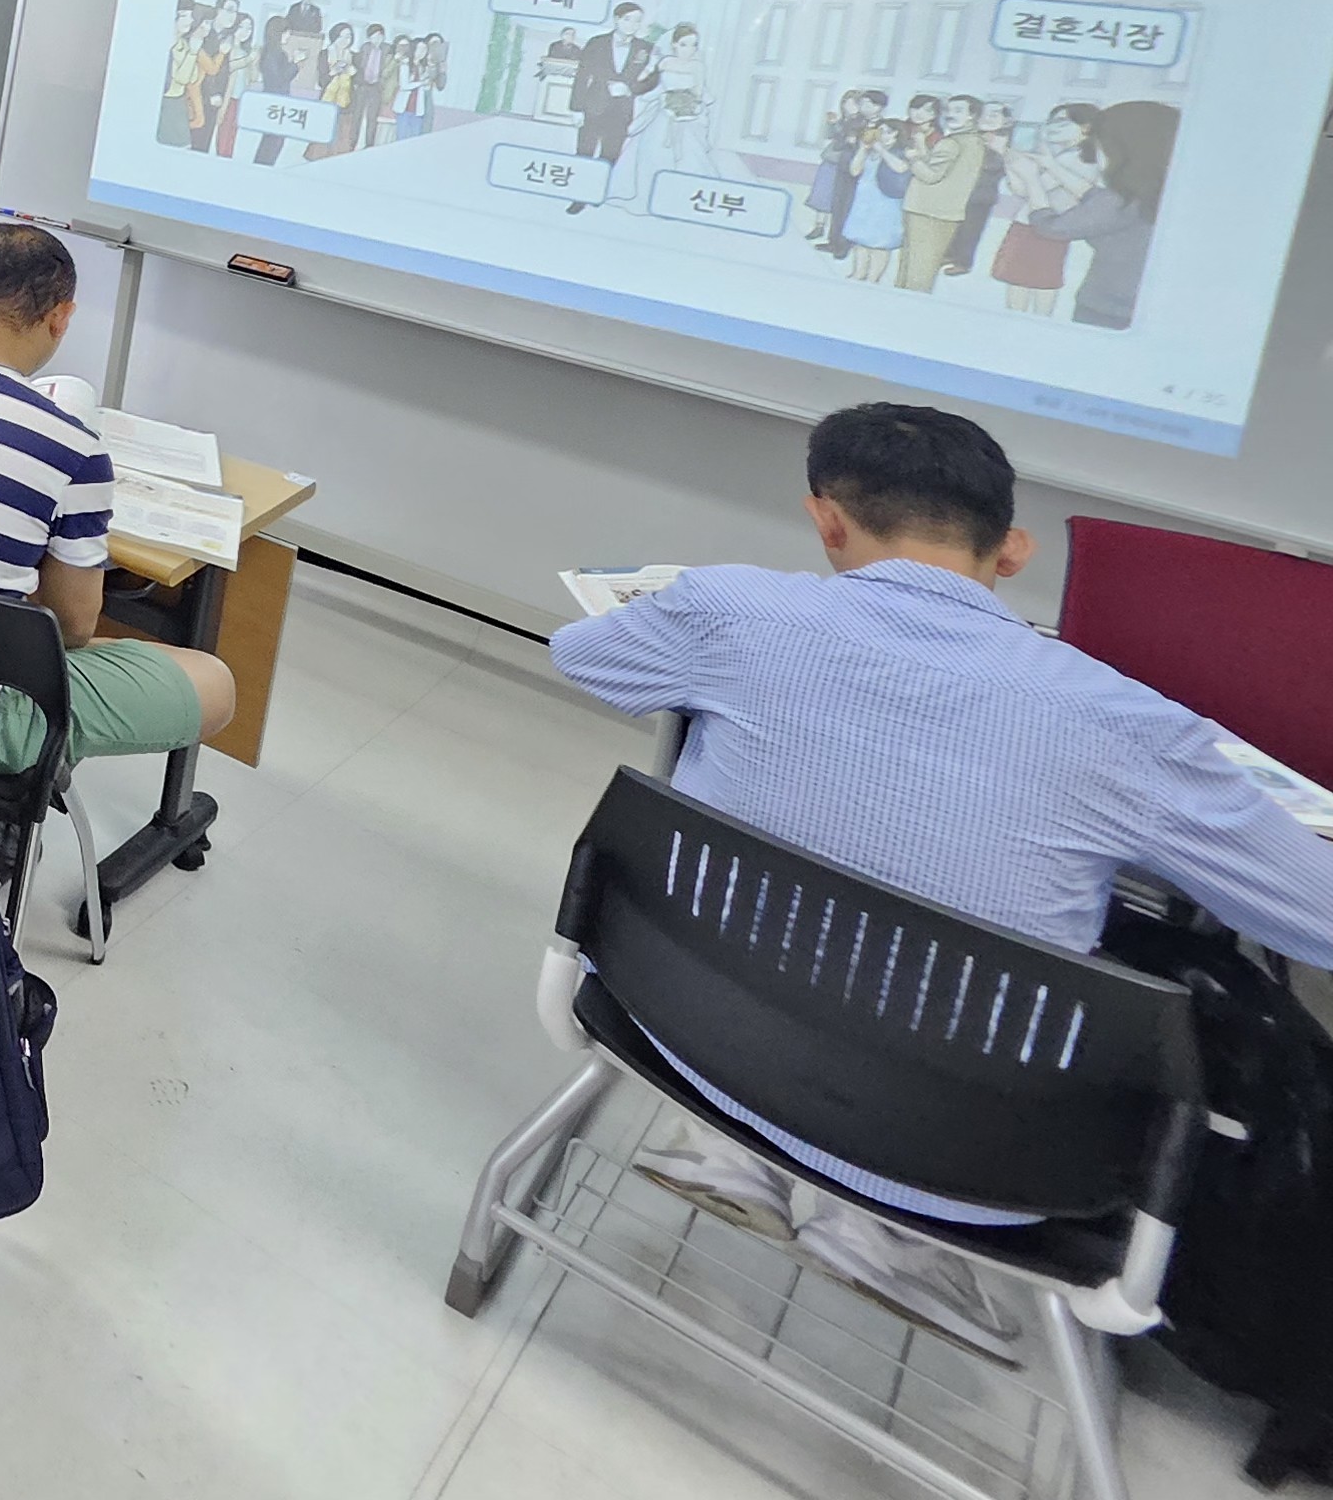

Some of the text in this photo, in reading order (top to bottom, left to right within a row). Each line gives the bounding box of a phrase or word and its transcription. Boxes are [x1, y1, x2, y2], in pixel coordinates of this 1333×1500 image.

[1012, 11, 1165, 52] 결혼식장
[265, 104, 310, 130] 하객
[523, 160, 576, 188] 신랑
[689, 188, 748, 218] 신부
